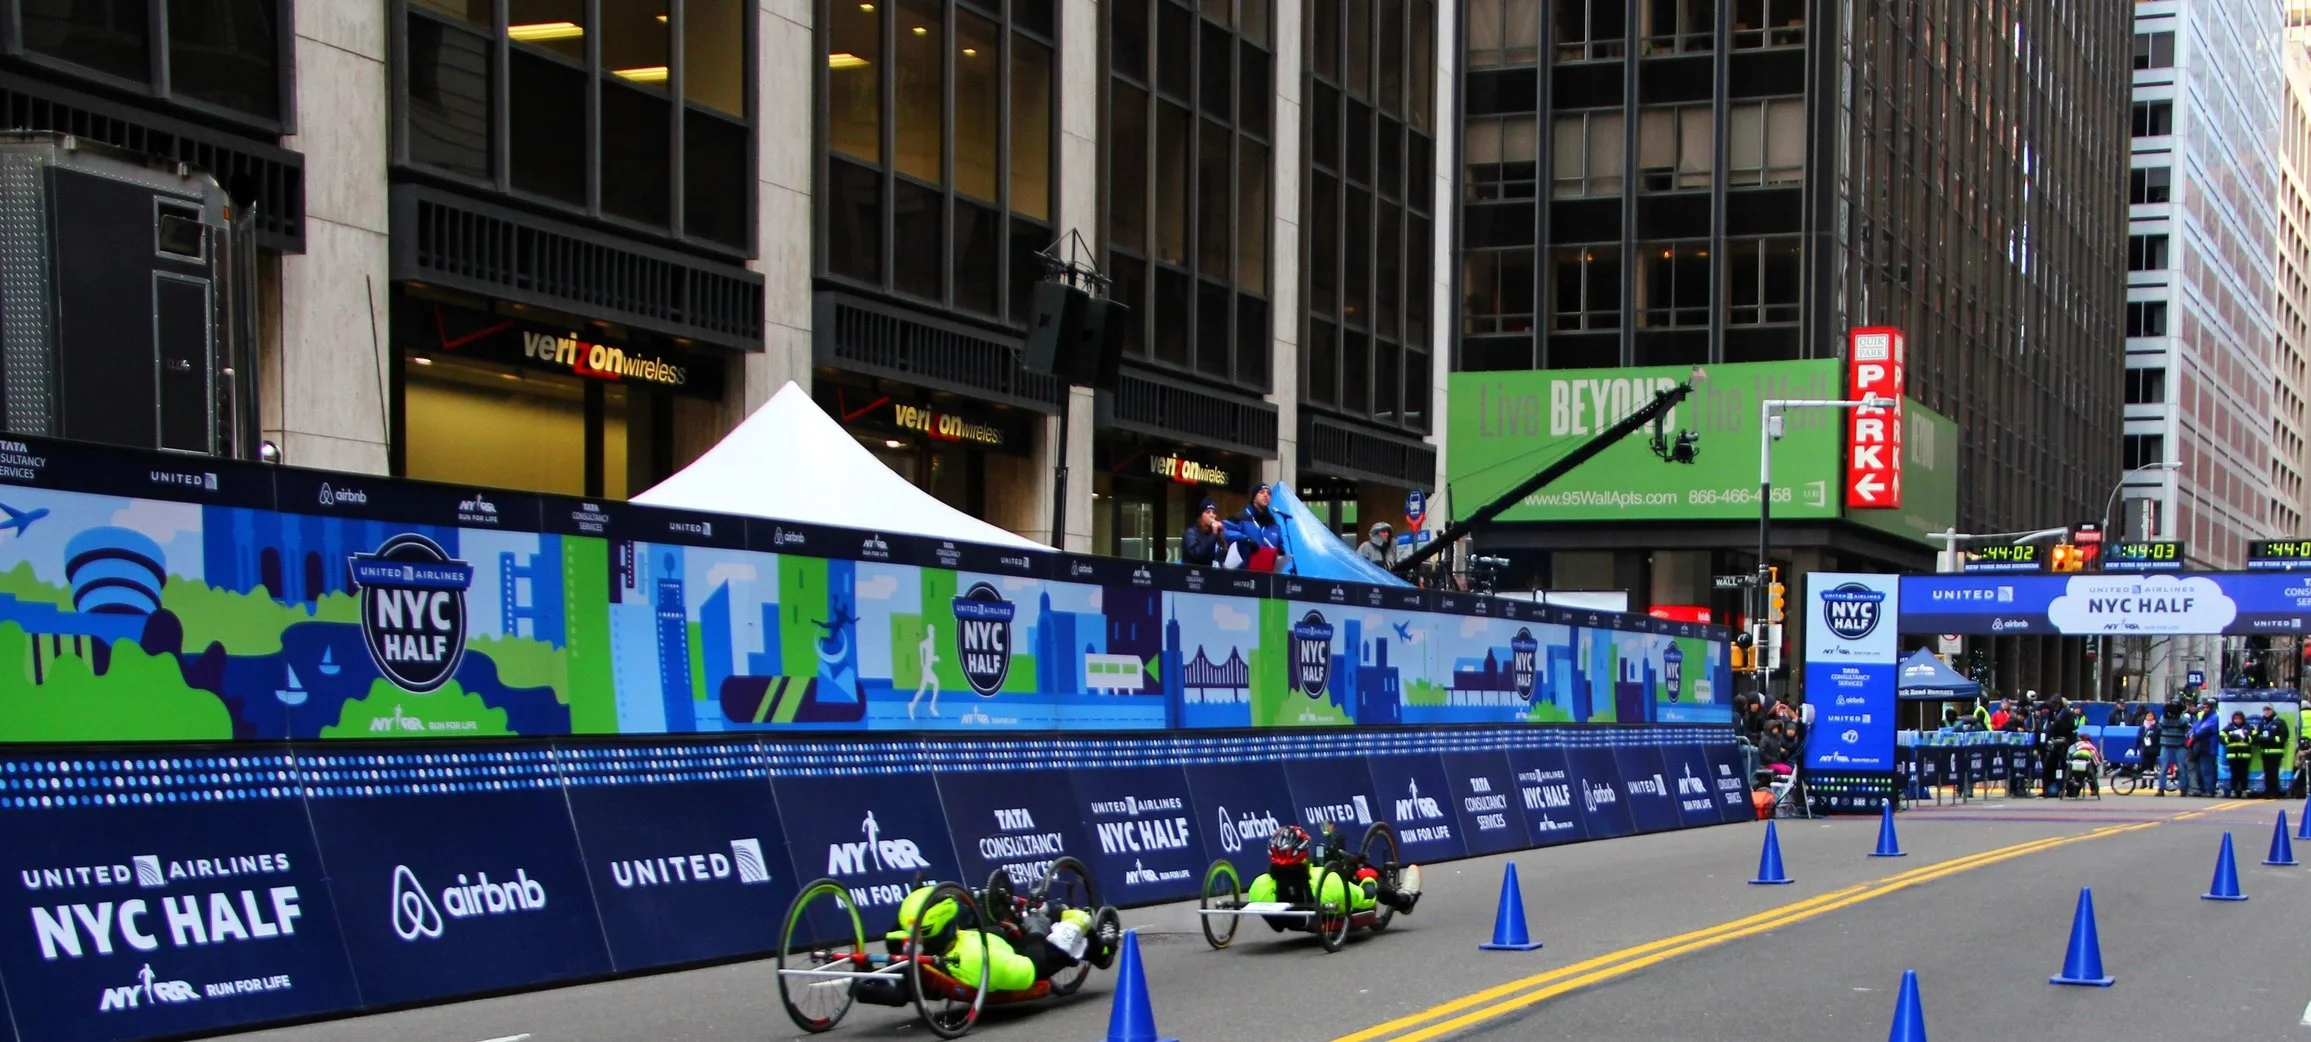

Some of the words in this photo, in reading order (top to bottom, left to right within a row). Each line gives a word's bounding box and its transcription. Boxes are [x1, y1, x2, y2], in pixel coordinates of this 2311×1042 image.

[1859, 337, 1885, 347] QUIK
[1859, 349, 1885, 358] PARK
[1479, 381, 1539, 438] Live
[1854, 364, 1885, 469] PARK
[151, 471, 202, 486] UNITED
[335, 488, 367, 503] airbnb
[1524, 490, 1677, 509] www.95WallApts.com
[1688, 487, 1792, 504] 866-466-458
[458, 513, 472, 521] RUN
[472, 514, 484, 522] FOR
[669, 522, 702, 533] UNITED
[784, 532, 805, 543] airbnb
[1000, 557, 1023, 565] UNITED
[360, 566, 402, 578] UNITED
[415, 570, 465, 581] AIRLINES
[1716, 578, 1738, 586] WALL
[1932, 590, 1995, 600] UNITED
[377, 588, 452, 630] NYC
[956, 604, 978, 613] UNITED
[984, 607, 1011, 616] AIRLINES
[1832, 601, 1873, 618] NYC
[2089, 598, 2132, 614] NYC
[2138, 597, 2194, 613] HALF
[1834, 618, 1869, 630] HALF
[2004, 619, 2029, 628] airbnb
[964, 620, 1003, 652] NYC
[385, 634, 447, 661] HALF
[1301, 640, 1326, 663] NYC
[967, 653, 1001, 674] HALF
[1515, 652, 1533, 672] NYC
[1666, 662, 1680, 679] NYC
[1302, 665, 1324, 682] HALF
[1516, 673, 1532, 687] HALF
[1541, 770, 1565, 779] AIRLINES
[1470, 777, 1491, 792] TATA
[1592, 782, 1616, 803] airbnb
[1627, 779, 1656, 794] UNITED
[1464, 794, 1508, 812] CONSULTANCY
[1522, 787, 1546, 809] NYC
[1542, 784, 1570, 807] HALF
[1091, 801, 1126, 814] UNITED
[1138, 798, 1183, 811] AIRLINES
[1305, 803, 1355, 825] UNITED
[994, 808, 1035, 829] TATA
[1238, 810, 1279, 839] airbnb
[1477, 814, 1507, 830] SERVICES
[1097, 822, 1140, 854] NYC
[1138, 817, 1190, 851] HALF
[1400, 829, 1418, 844] RUN
[1417, 827, 1433, 842] FOR
[1432, 825, 1450, 839] LIFE
[979, 833, 1064, 858] CONSULTANCY
[828, 838, 931, 875] NYRR
[21, 864, 131, 889] UNITED
[169, 852, 290, 878] AIRLINES
[611, 852, 731, 887] UNITED
[442, 868, 545, 917] airbnb
[870, 884, 904, 904] FOR
[31, 899, 158, 959] NYC
[162, 886, 301, 946] HALF
[100, 979, 201, 1011] NYRR
[206, 982, 236, 997] RUN
[236, 979, 262, 993] FOR
[263, 974, 291, 989] LIFE
